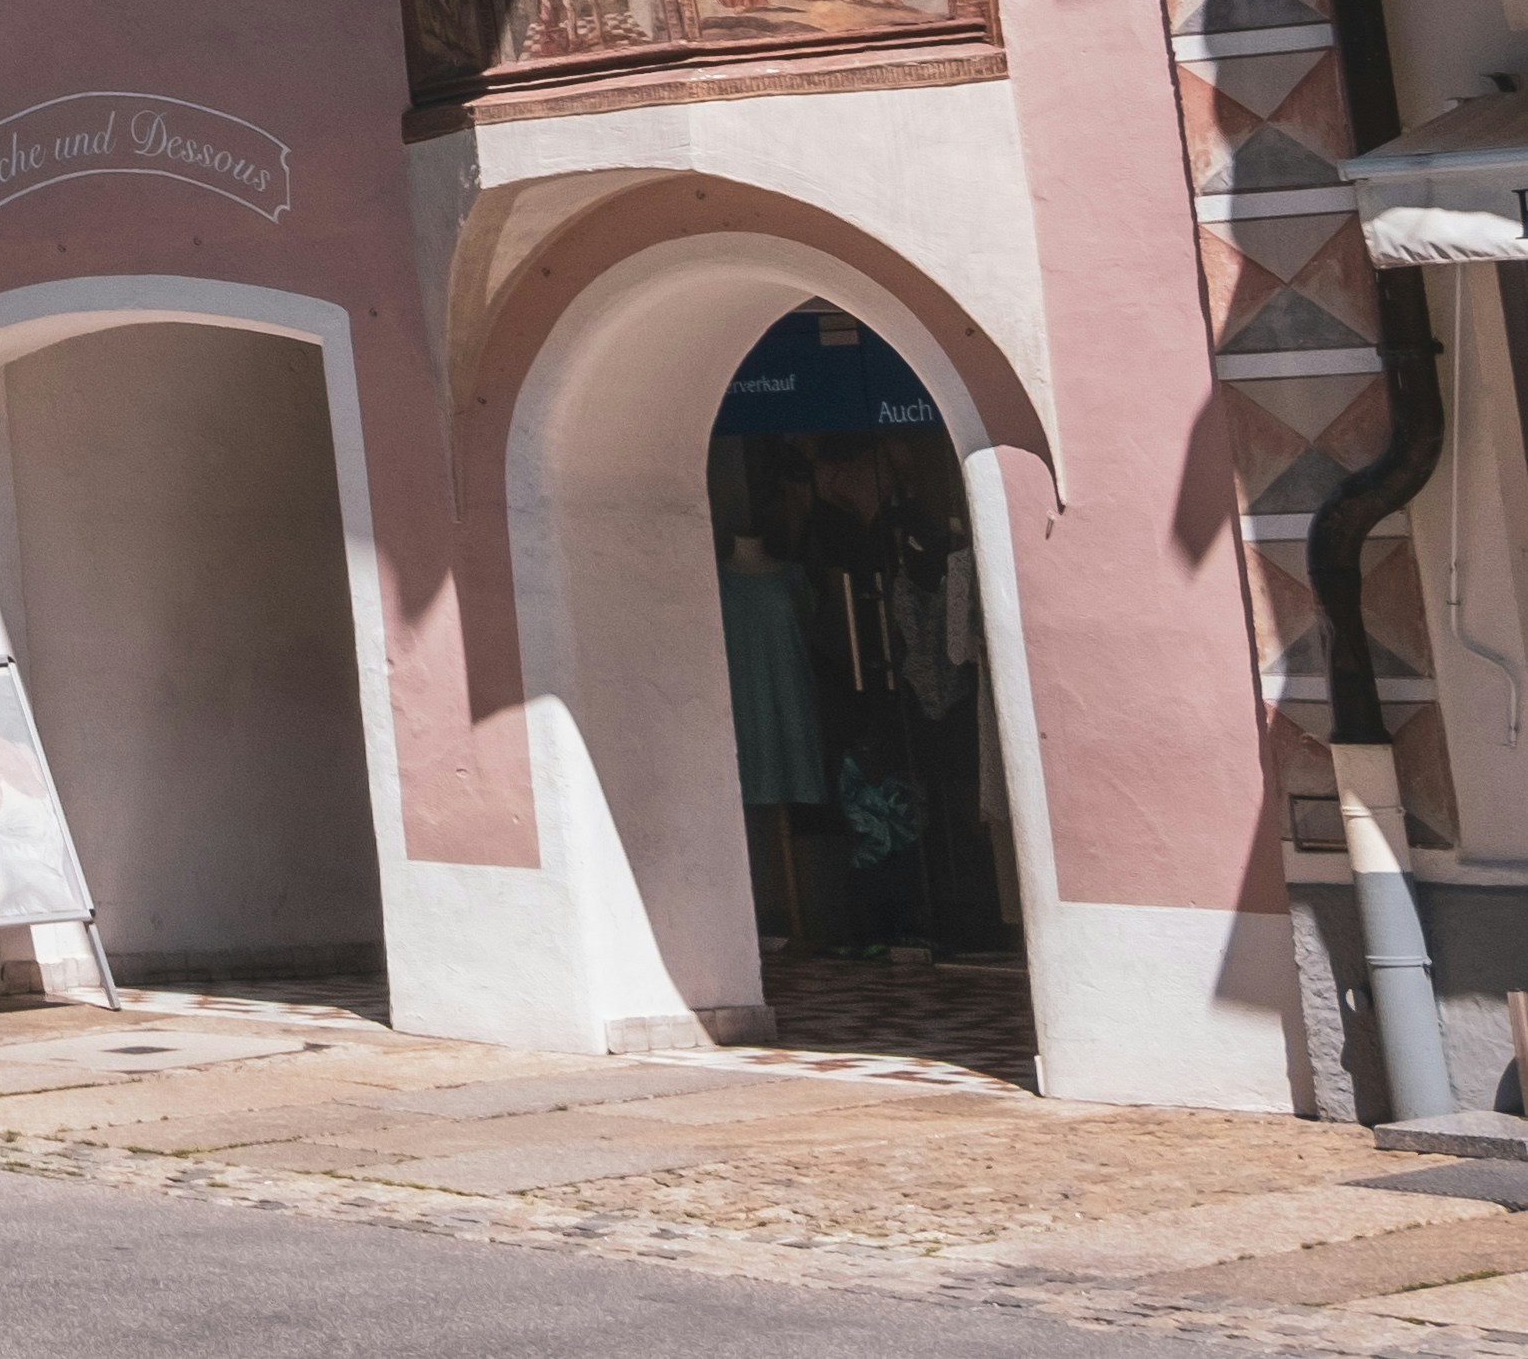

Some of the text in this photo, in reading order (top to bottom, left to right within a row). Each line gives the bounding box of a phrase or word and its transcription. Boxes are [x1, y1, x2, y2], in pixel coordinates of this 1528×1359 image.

[54, 110, 117, 162] und
[130, 109, 272, 193] Dessous
[878, 398, 934, 424] Auch
